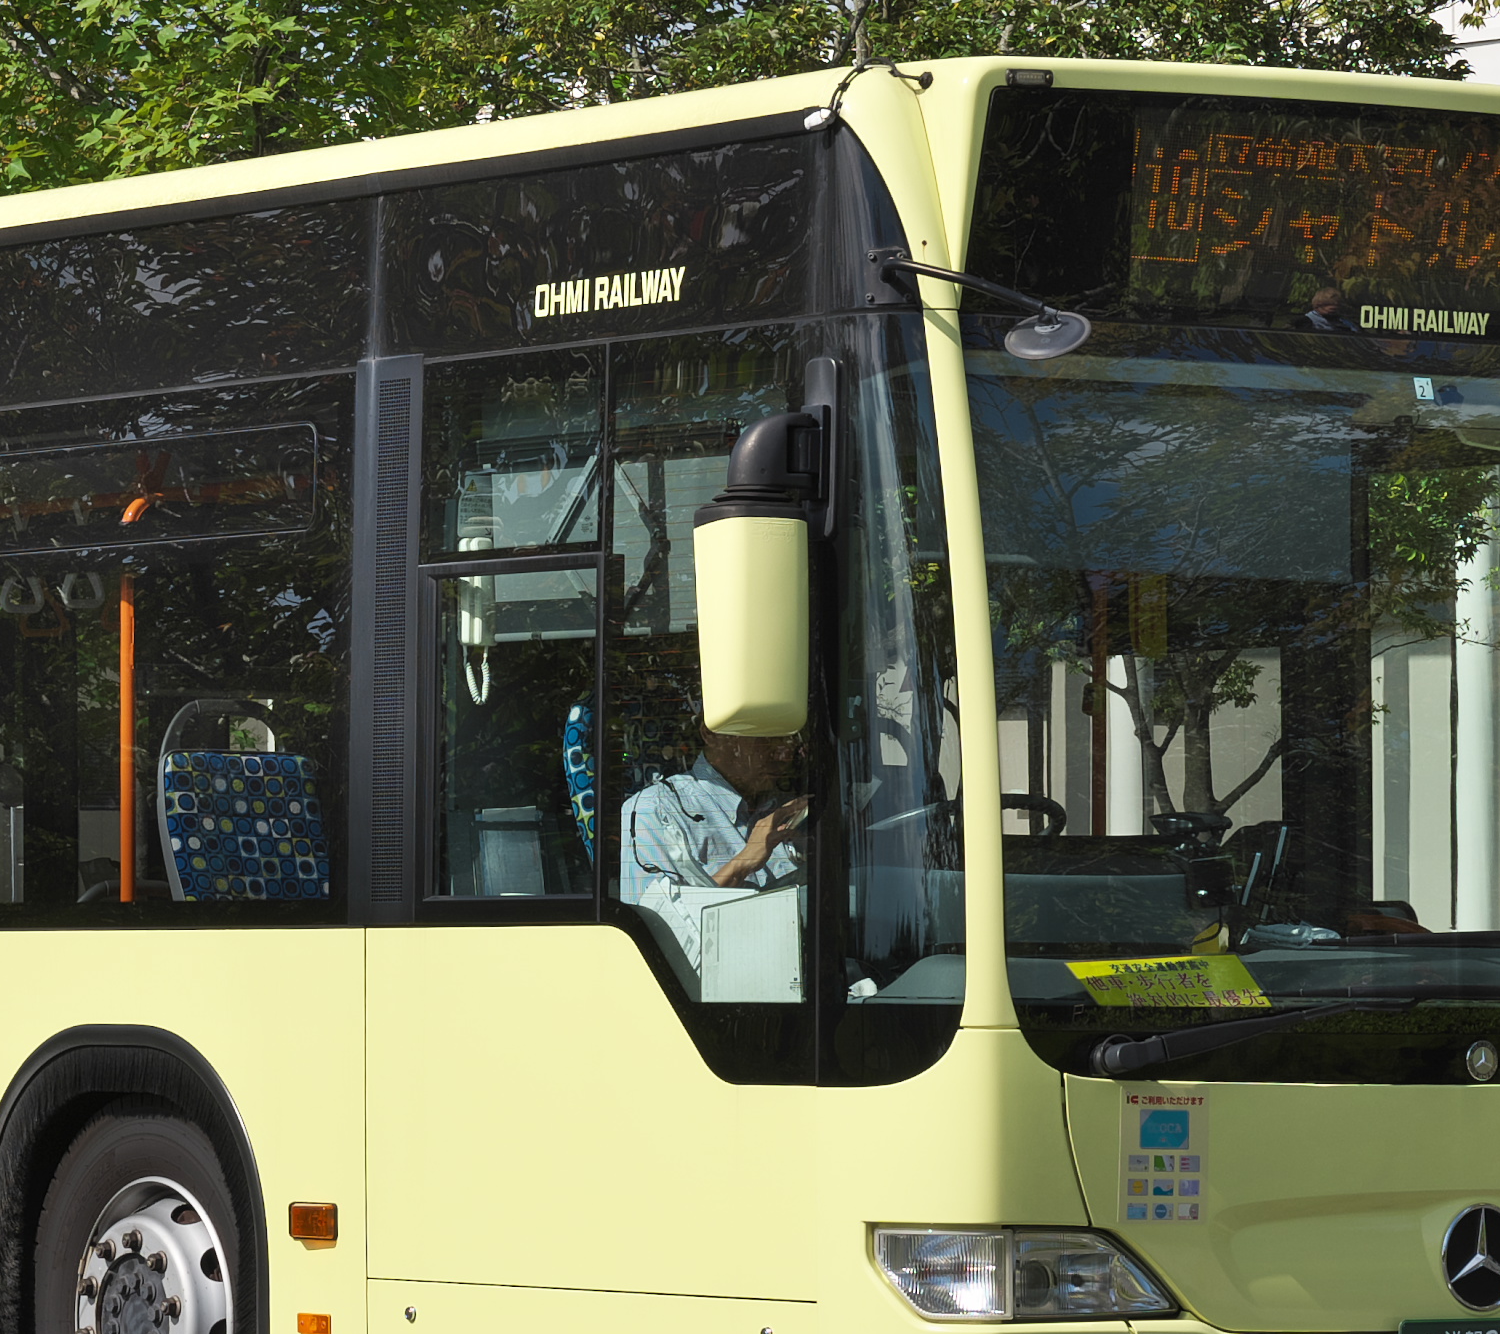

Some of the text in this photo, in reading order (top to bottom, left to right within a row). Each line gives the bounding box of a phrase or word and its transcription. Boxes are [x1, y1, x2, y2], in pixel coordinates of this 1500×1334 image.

[534, 266, 686, 318] OHMI RAILWAY
[1360, 305, 1490, 336] OHMI RAILWAY
[1085, 972, 1213, 992] 他車・歩行者を
